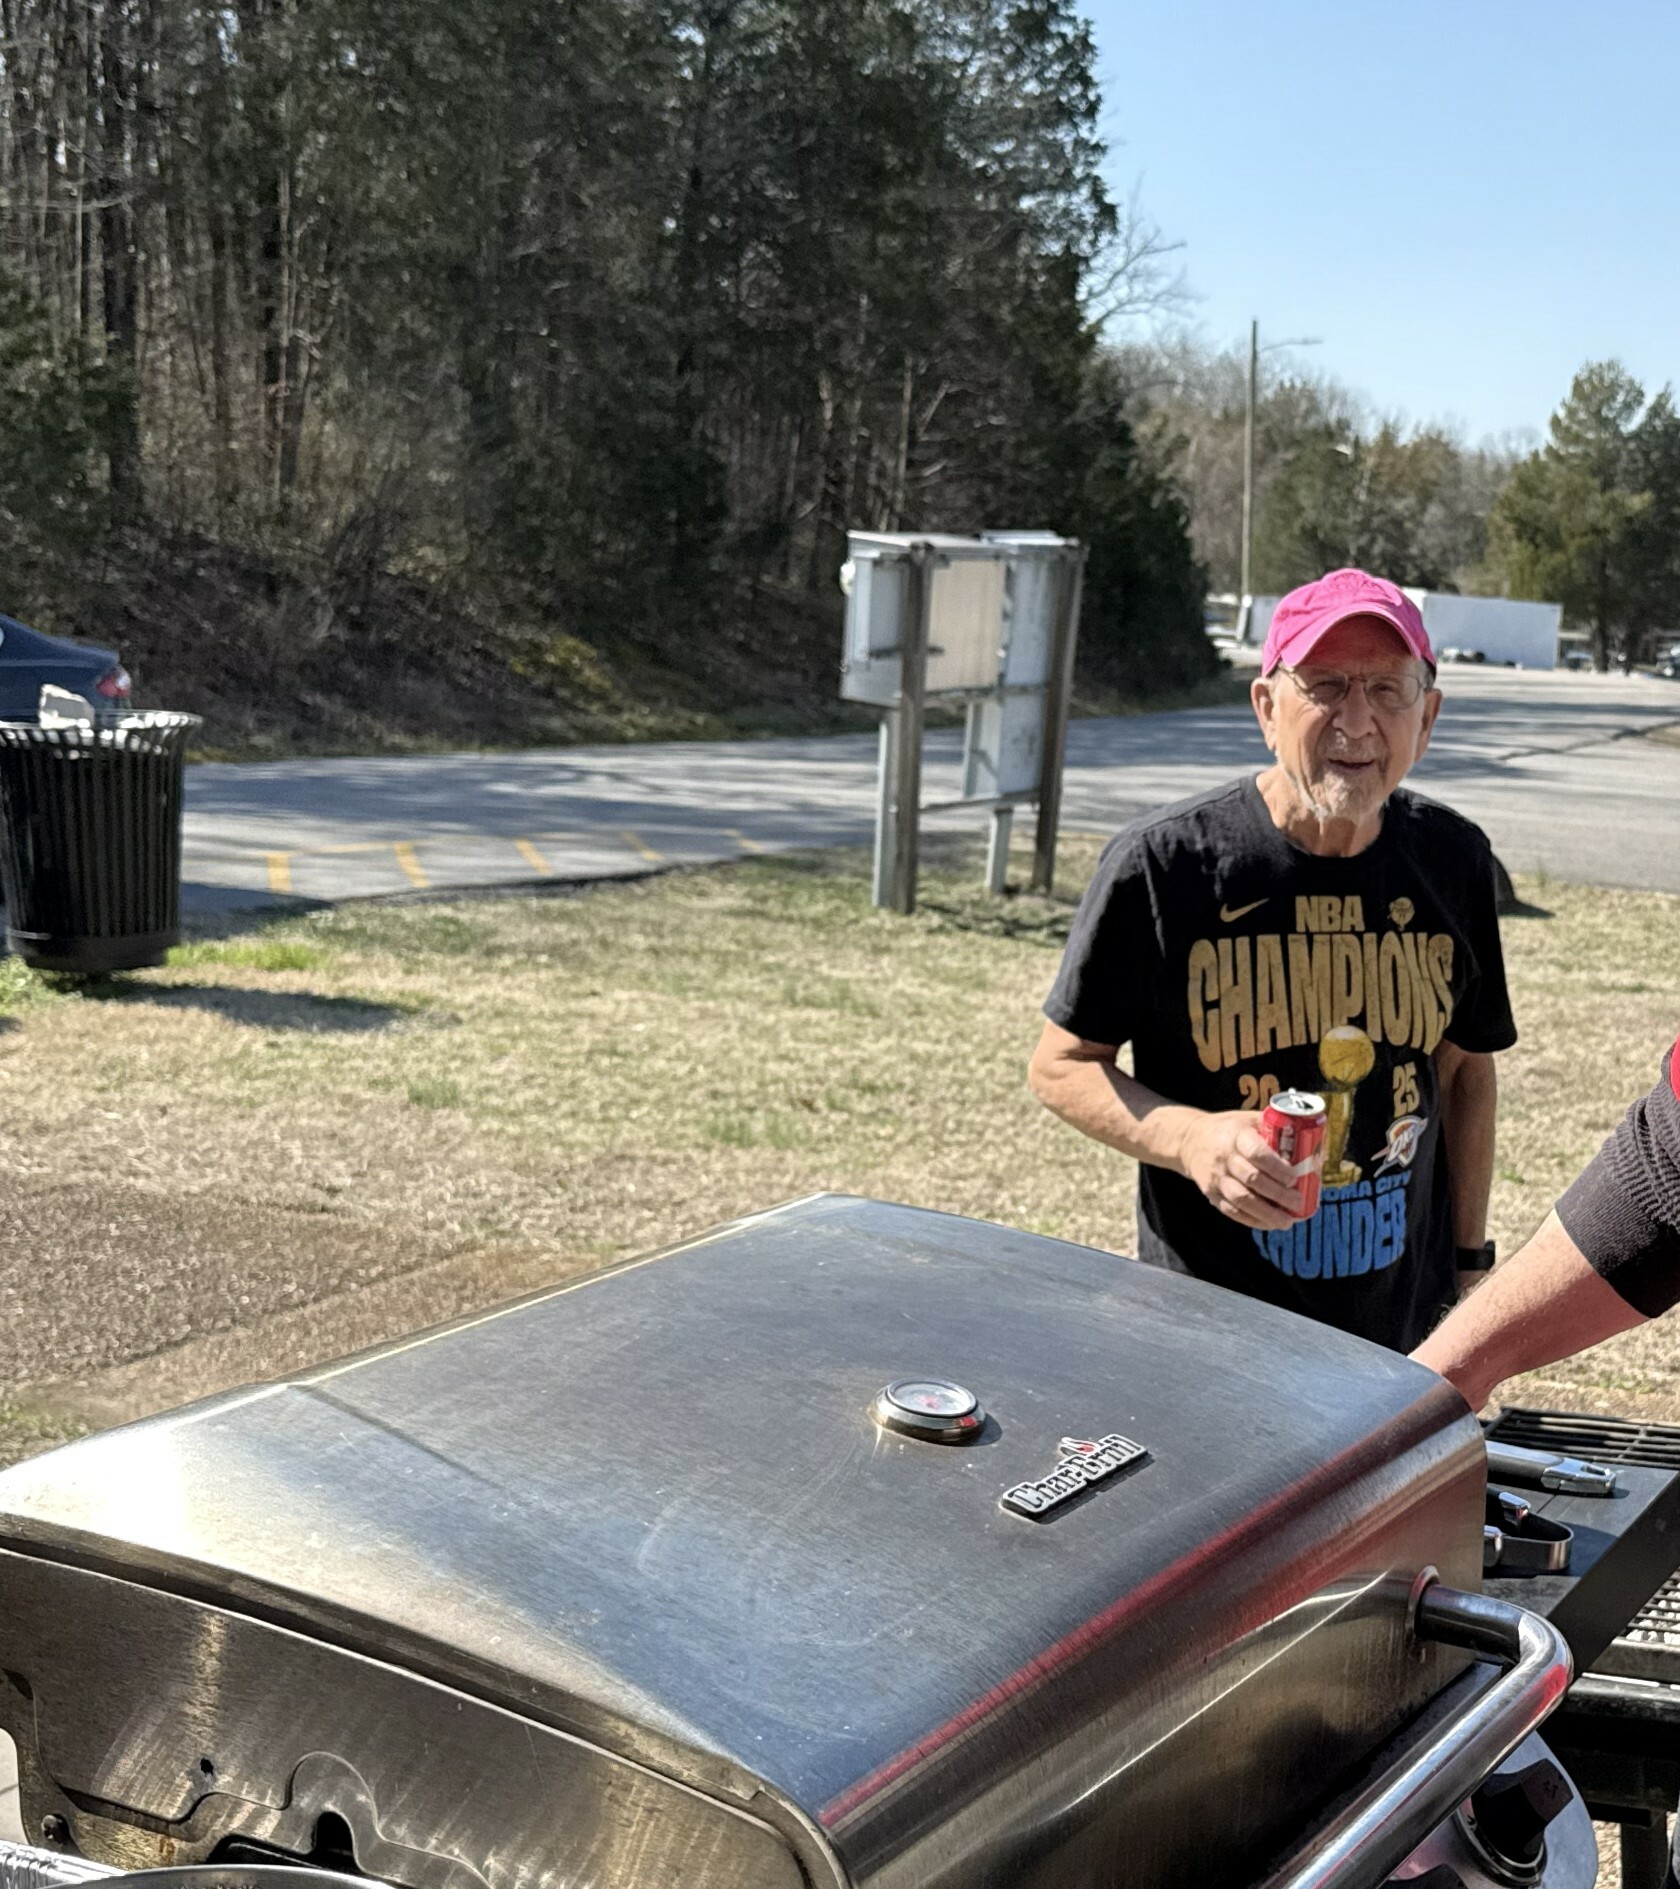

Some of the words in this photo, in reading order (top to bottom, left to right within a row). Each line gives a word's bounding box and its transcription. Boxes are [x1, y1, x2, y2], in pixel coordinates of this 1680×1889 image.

[1295, 895, 1365, 932] NBA
[1187, 930, 1455, 1073] CHAMPIONS
[1238, 1073, 1281, 1111] 20
[1392, 1061, 1420, 1118] 25
